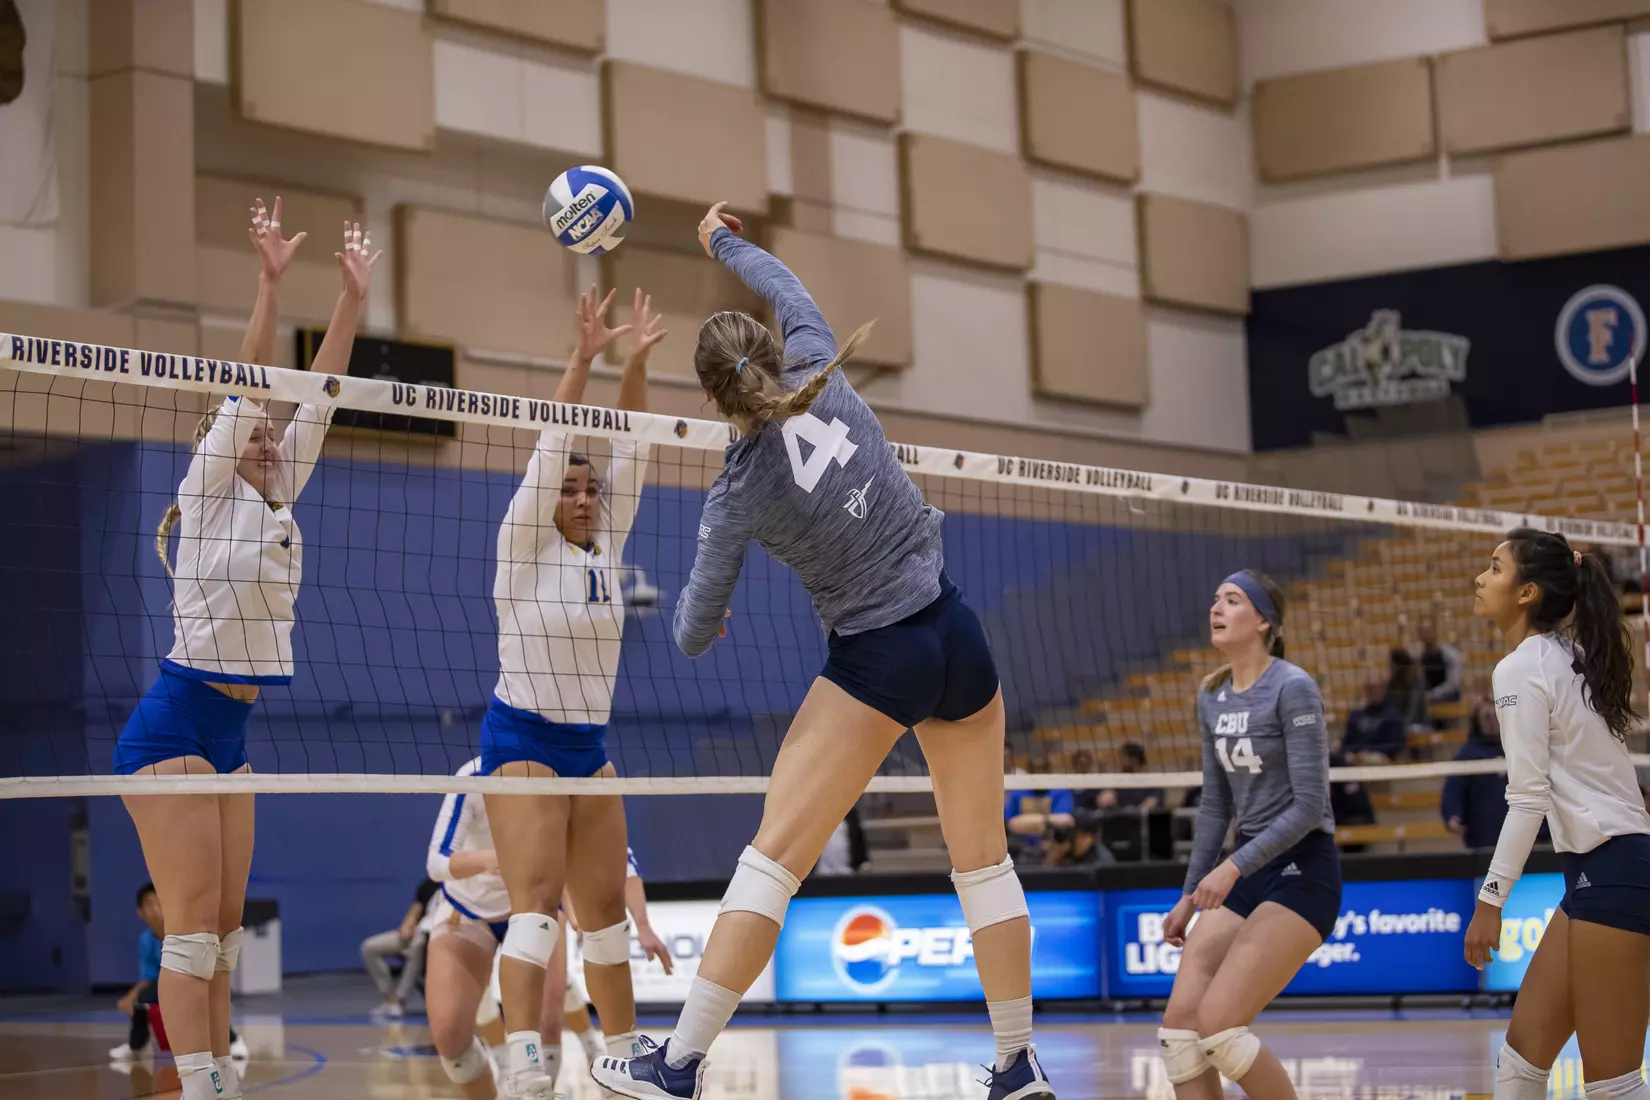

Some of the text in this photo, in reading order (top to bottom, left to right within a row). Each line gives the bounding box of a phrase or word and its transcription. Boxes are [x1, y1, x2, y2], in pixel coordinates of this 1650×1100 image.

[556, 193, 596, 229] molten
[568, 207, 604, 241] NCAA
[1585, 308, 1618, 365] F
[11, 336, 271, 389] RIVERSIDE VOLLEYBALL
[392, 383, 631, 432] UC RIVERSIDE VOLLEYBALL
[781, 412, 859, 493] 4
[897, 445, 919, 465] ALL
[998, 458, 1152, 491] UC RIVERSIDE VOLLEYBALL
[1215, 711, 1250, 734] CBU
[1214, 737, 1263, 774] 14
[1332, 908, 1461, 940] y's favorite
[1498, 908, 1556, 963] go
[1125, 942, 1184, 974] LIG
